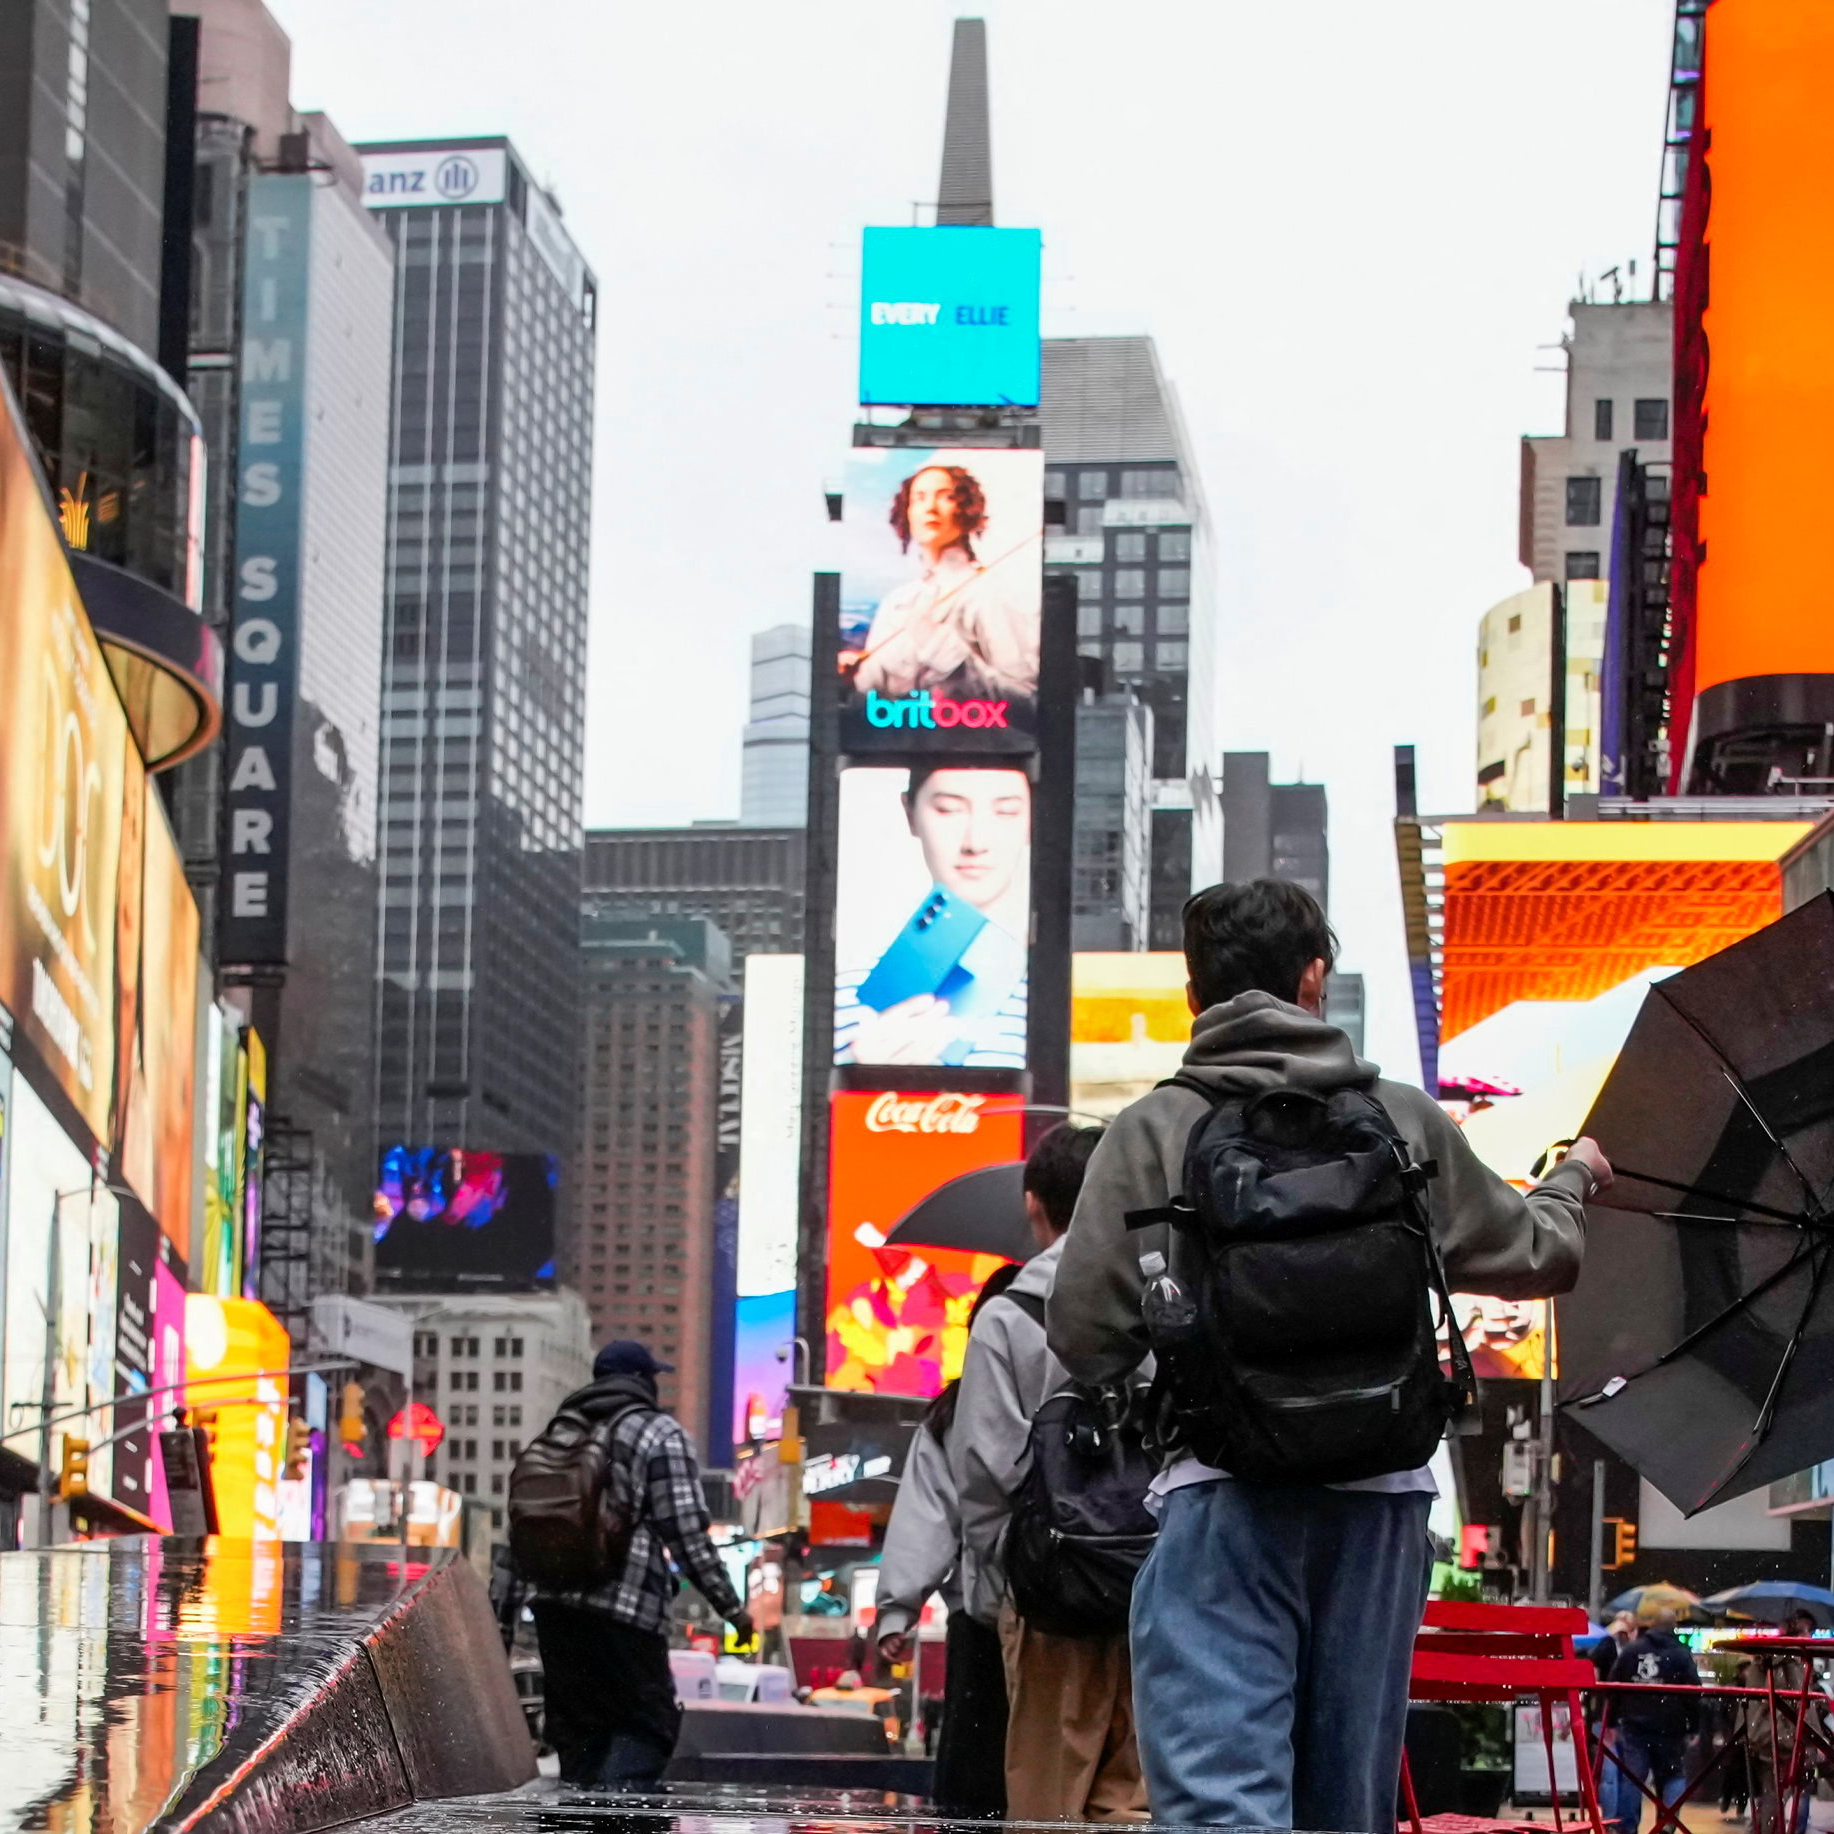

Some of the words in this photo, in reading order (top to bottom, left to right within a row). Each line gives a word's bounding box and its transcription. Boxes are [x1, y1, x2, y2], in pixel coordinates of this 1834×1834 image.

[367, 164, 426, 194] anz
[870, 301, 941, 326] EVERY
[954, 304, 1010, 327] ELLIE
[238, 215, 291, 507] TIMES
[865, 689, 1009, 729] britbox
[230, 556, 283, 919] SQUARE
